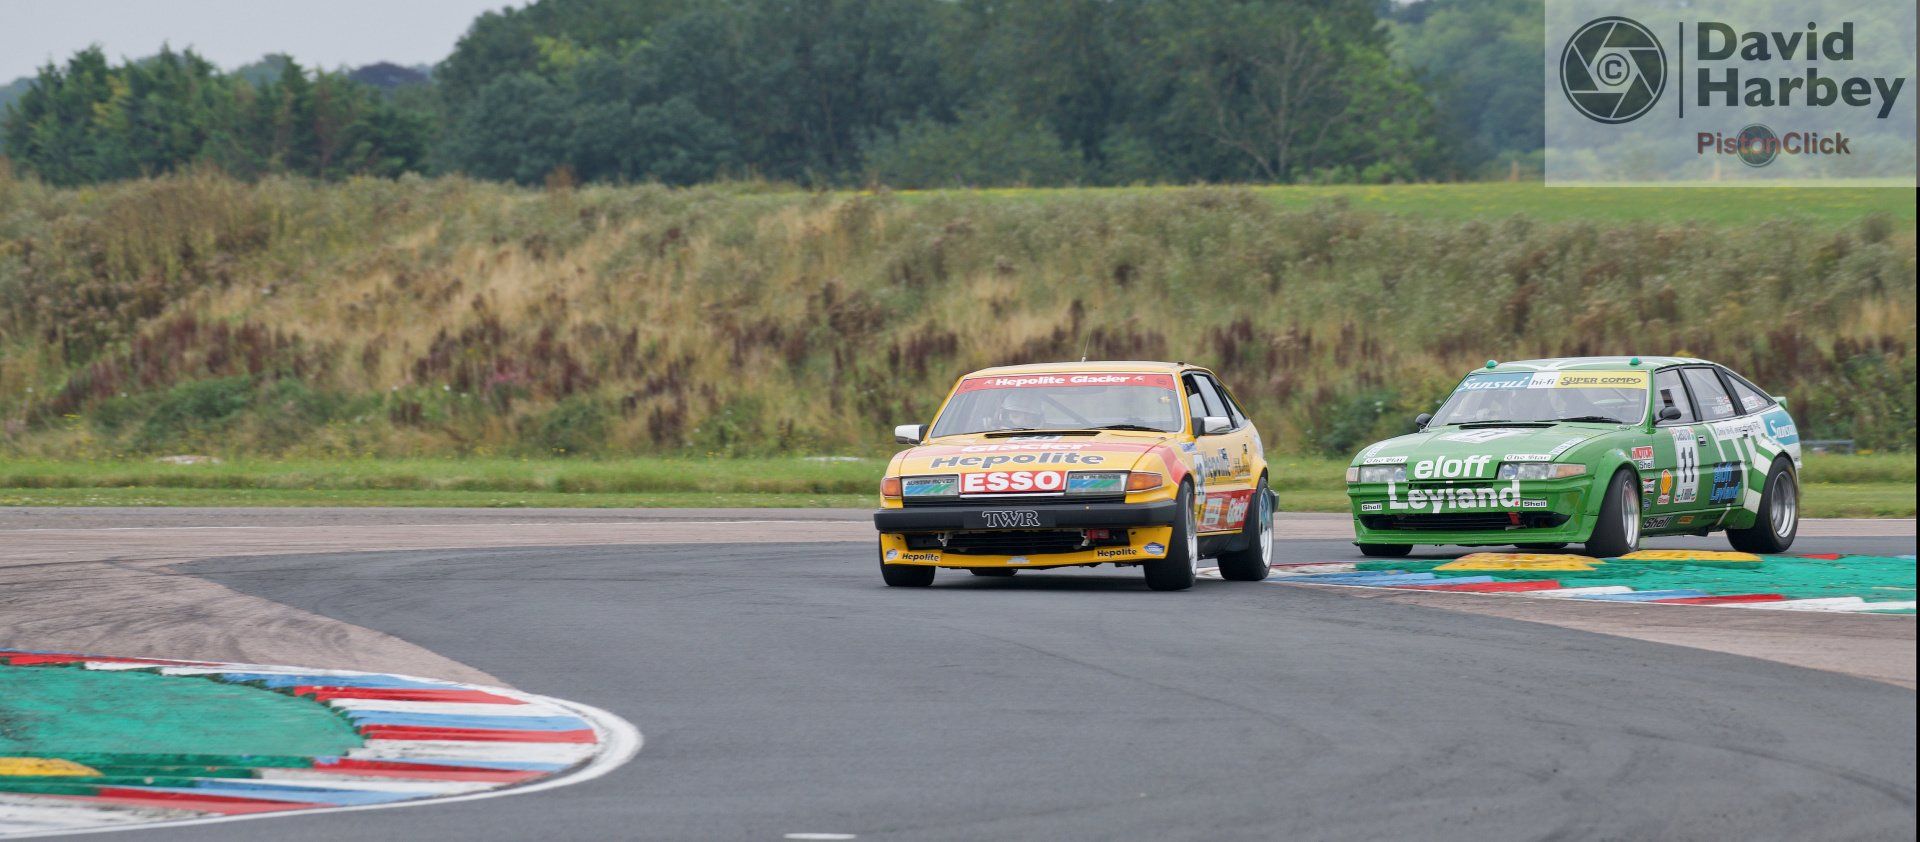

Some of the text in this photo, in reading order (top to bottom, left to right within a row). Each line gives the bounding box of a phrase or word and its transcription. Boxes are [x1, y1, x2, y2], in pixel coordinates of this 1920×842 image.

[996, 375, 1130, 387] Hepolite Glacier
[1459, 375, 1555, 390] Sansui hi-fi
[961, 442, 1093, 453] Glacier
[929, 451, 1105, 470] Hepolite
[1414, 455, 1493, 479] eloff
[1639, 461, 1654, 469] Shell
[1681, 447, 1695, 483] 11
[964, 471, 1062, 493] ESSO
[1387, 479, 1521, 513] Leyland
[982, 510, 1041, 528] TWR
[1643, 516, 1673, 529] Shell
[902, 553, 939, 561] Hepolite
[1097, 547, 1137, 558] Hepolite
